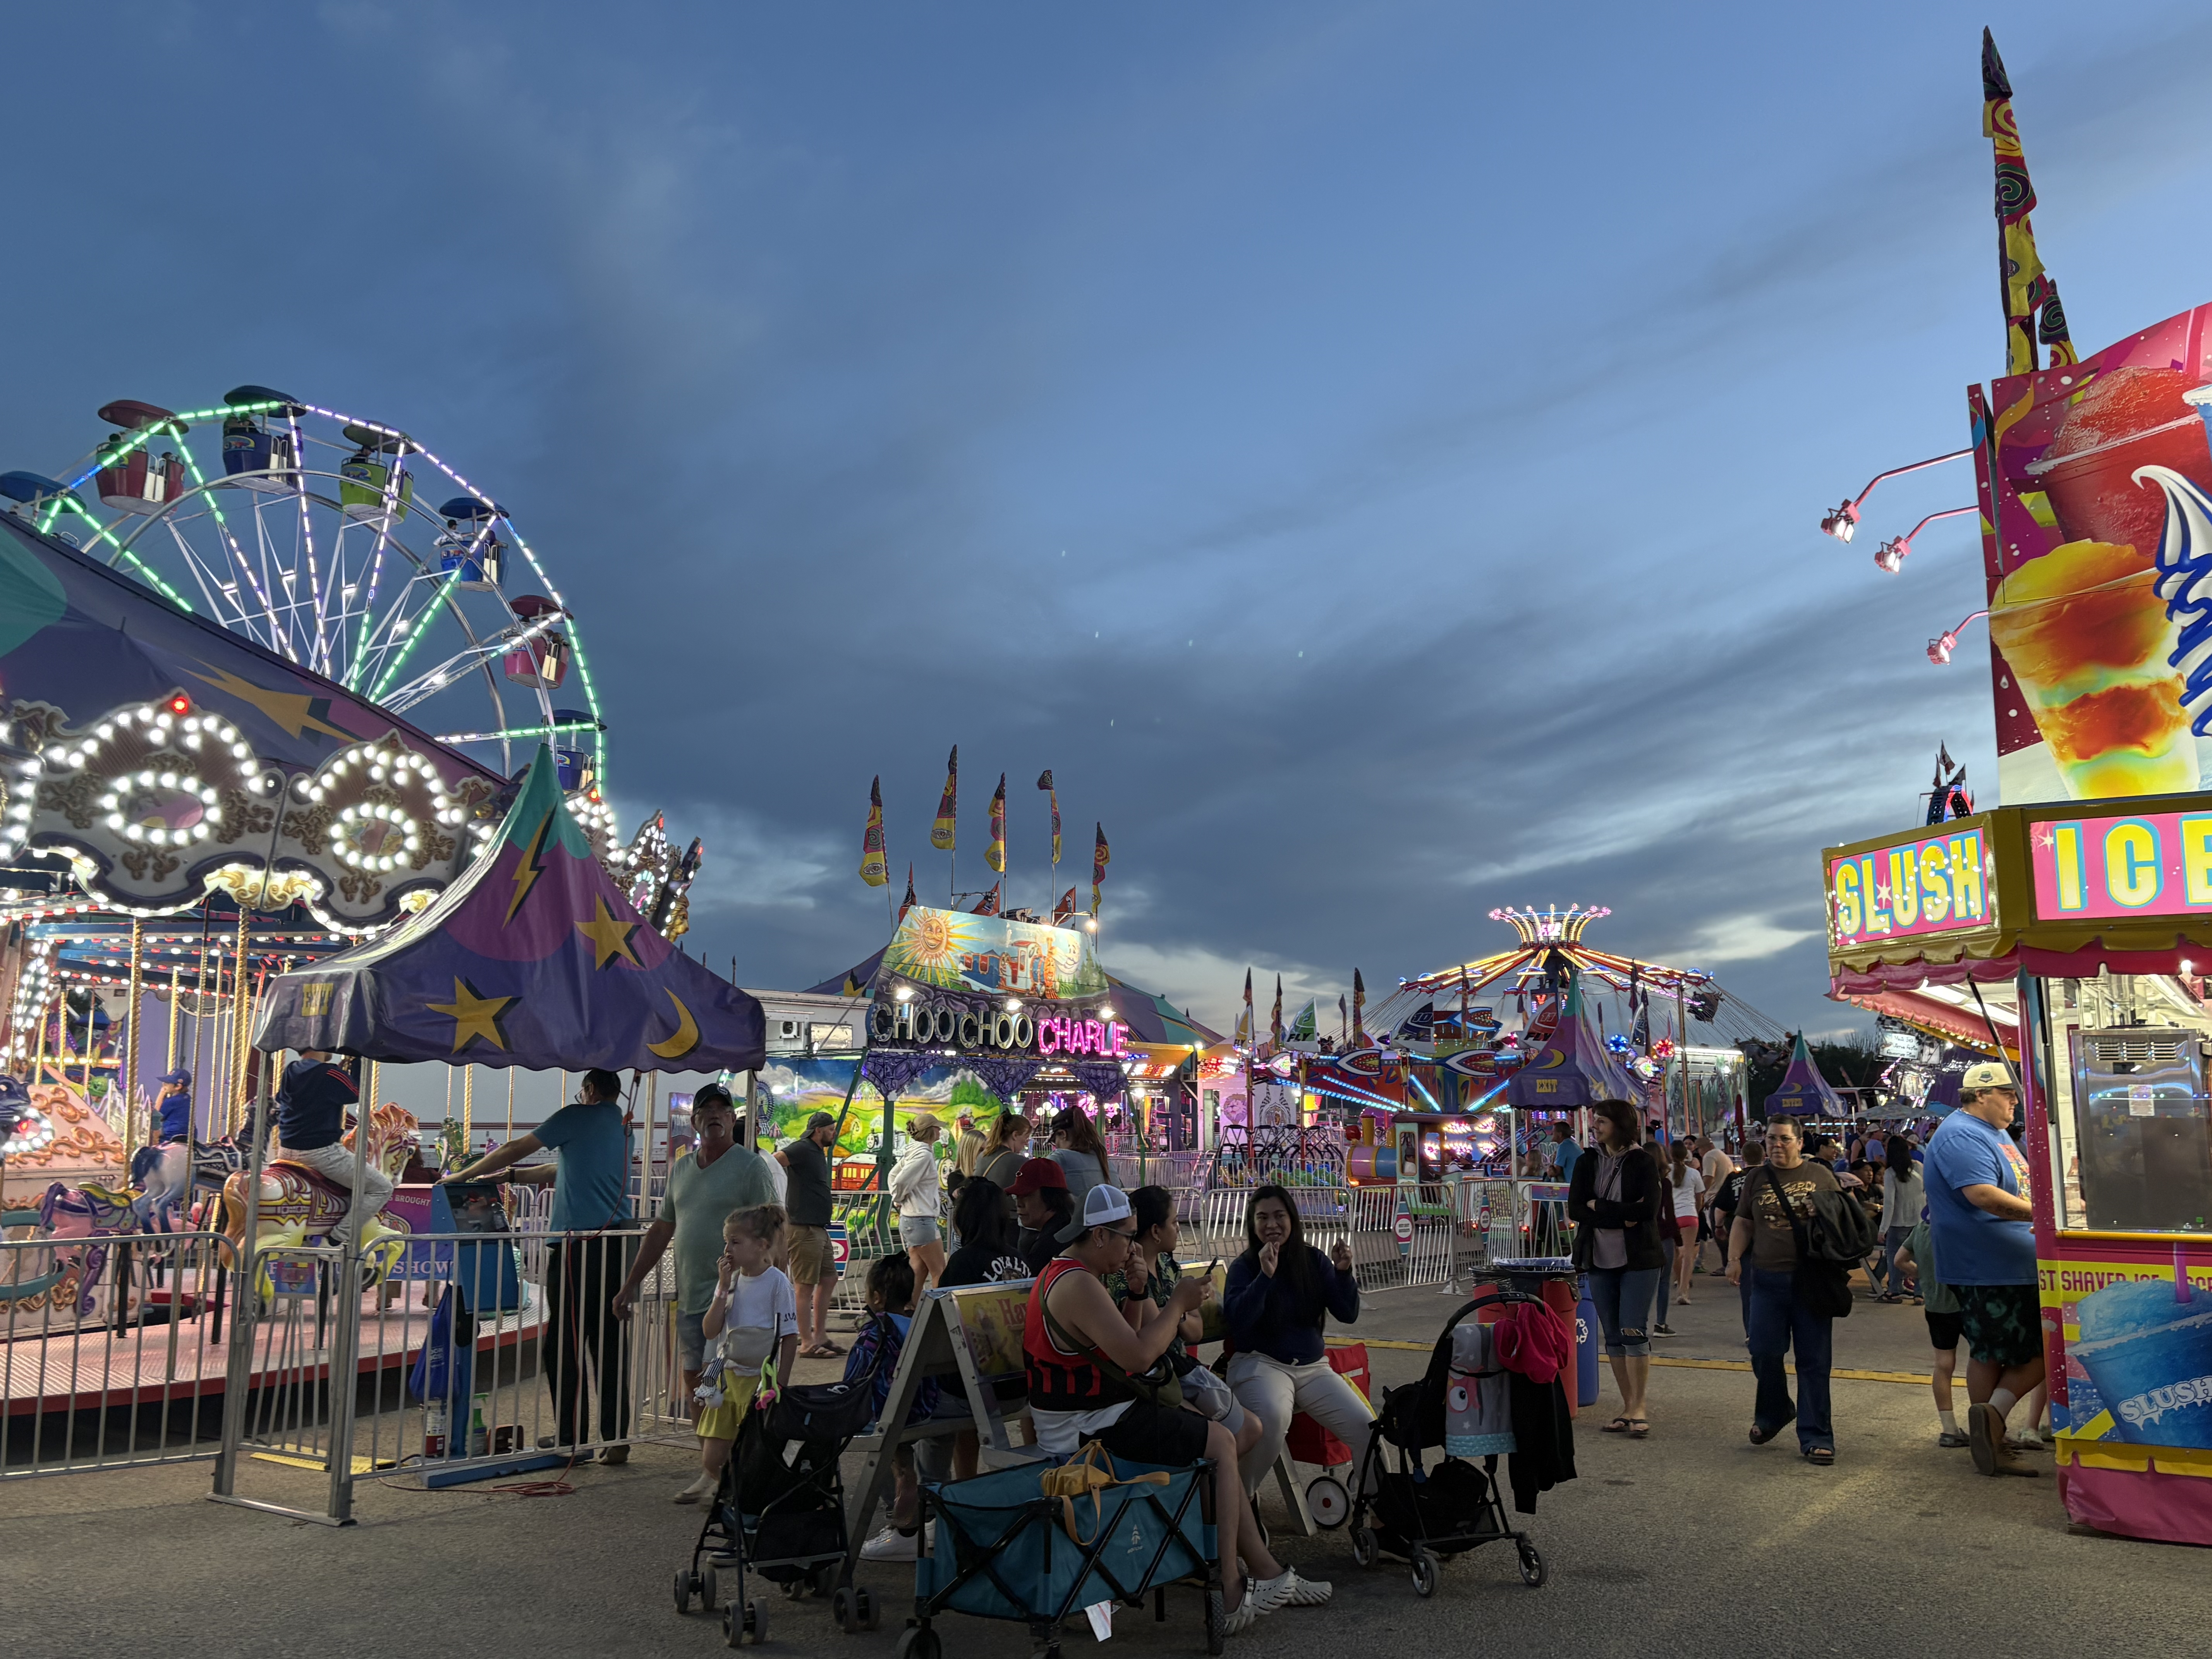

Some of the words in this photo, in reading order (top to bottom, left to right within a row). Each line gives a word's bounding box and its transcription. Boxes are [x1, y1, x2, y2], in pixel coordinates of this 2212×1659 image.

[2054, 813, 2212, 911] ICE
[1836, 830, 1985, 936] SLUSH
[302, 983, 333, 1016] EXIT
[1412, 1012, 1433, 1022] 10
[1540, 1012, 1556, 1022] 11
[867, 1001, 955, 1043] CHOO
[957, 1010, 1033, 1049] CHOO
[1287, 1033, 1311, 1042] FLY
[1524, 1032, 1552, 1041] FLY
[1536, 1079, 1557, 1092] EXIT
[1731, 1176, 1746, 1186] 202
[395, 1195, 431, 1206] BROUGHT
[982, 1256, 1031, 1282] LOYALTY
[2039, 1270, 2056, 1291] ST
